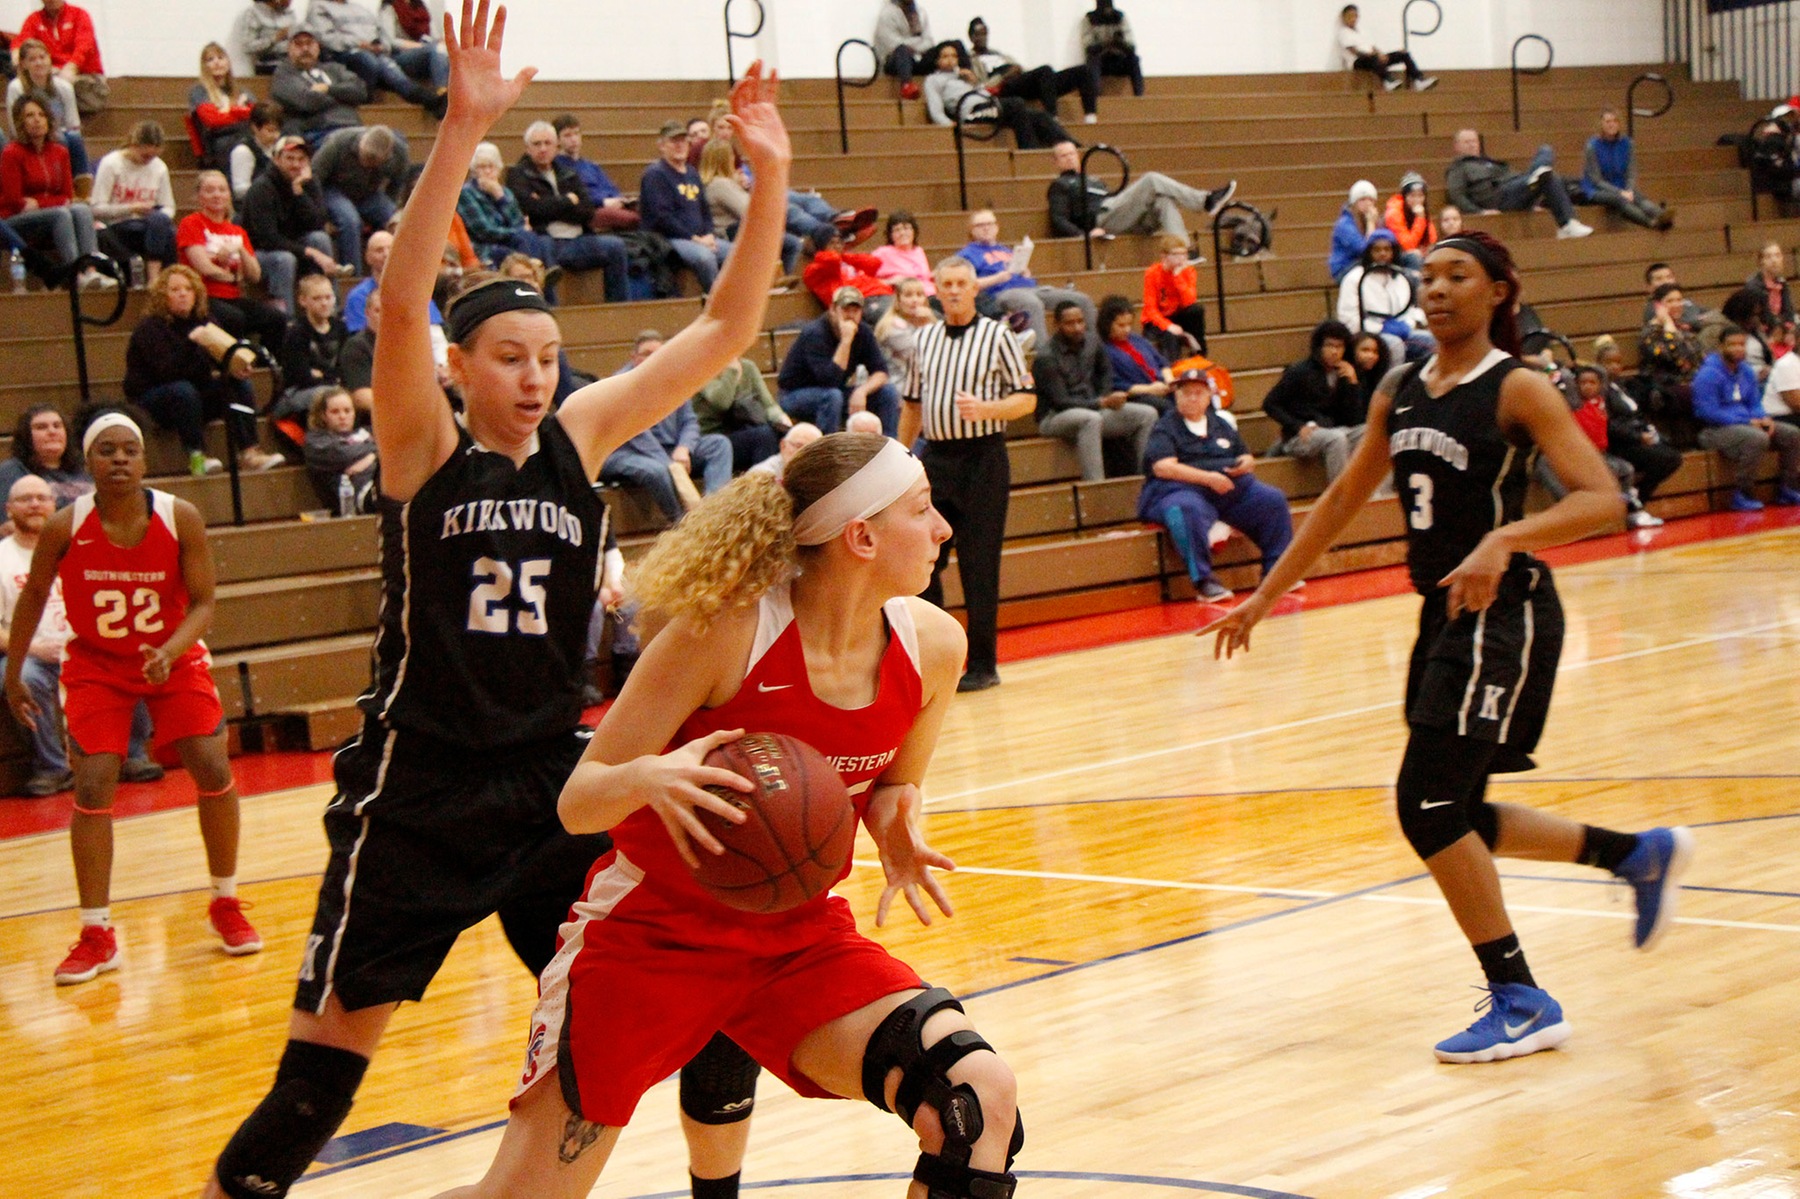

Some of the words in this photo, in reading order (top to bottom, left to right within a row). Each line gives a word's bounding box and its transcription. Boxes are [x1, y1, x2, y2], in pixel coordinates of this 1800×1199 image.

[1389, 427, 1470, 471] IRKWOOD
[440, 499, 583, 548] KIRKWOOD
[1408, 473, 1434, 530] 3
[93, 587, 165, 639] 22
[466, 556, 553, 635] 25
[1478, 684, 1506, 721] K
[951, 1098, 967, 1137] FUSION
